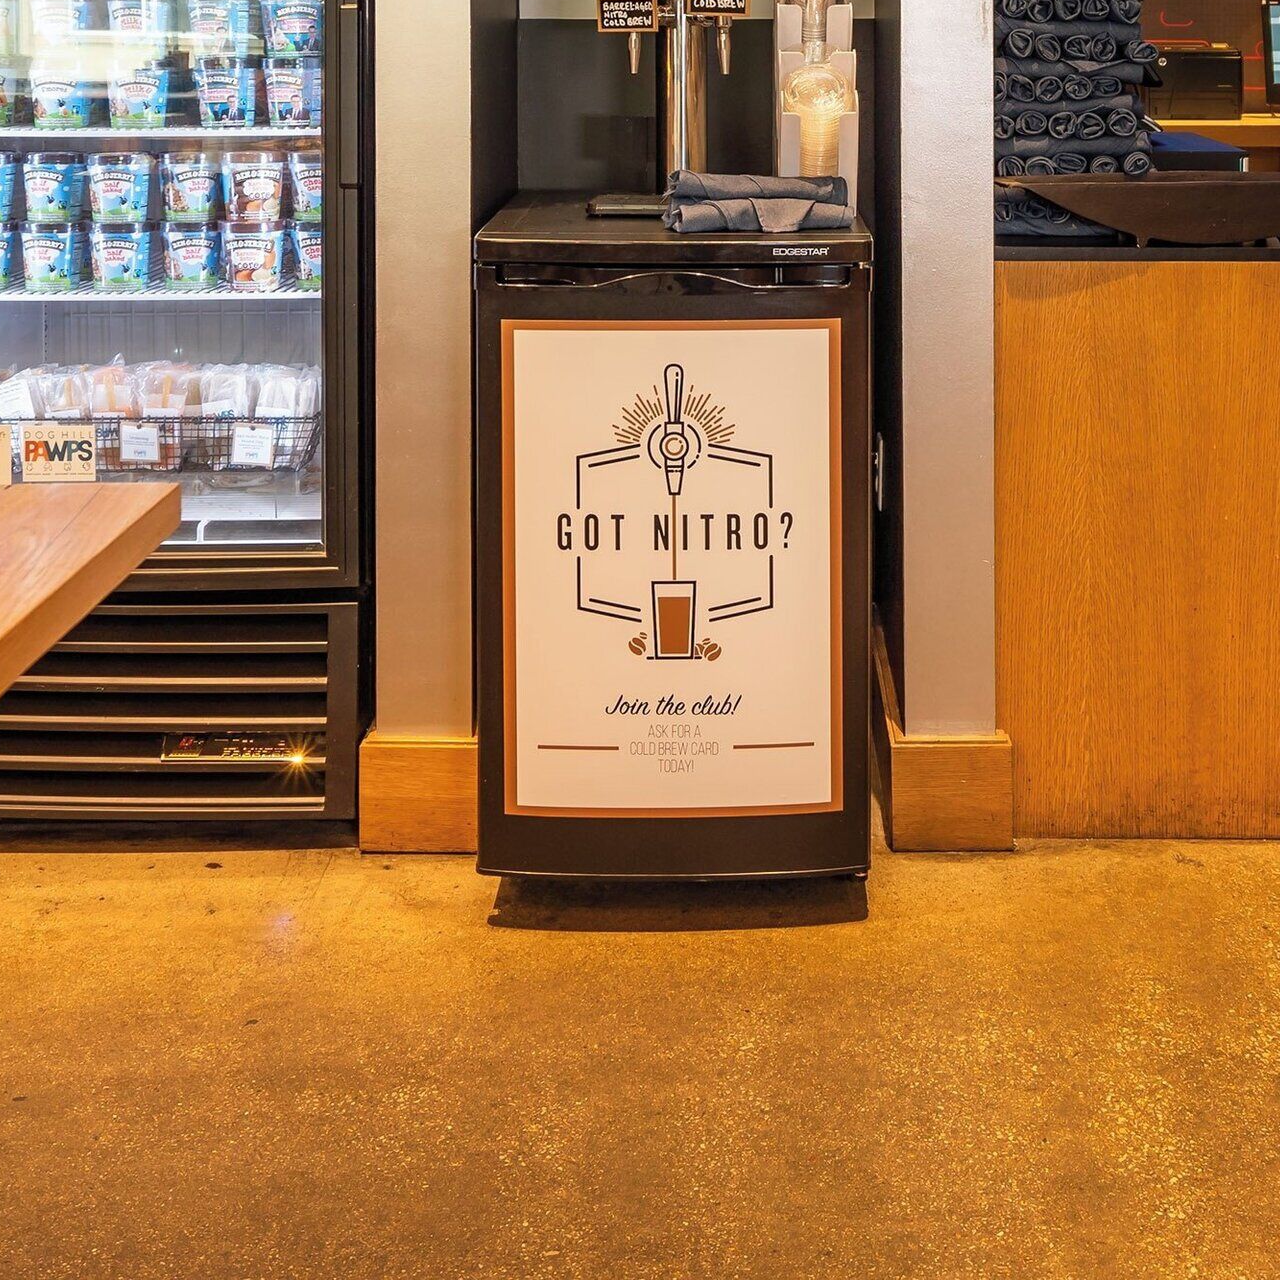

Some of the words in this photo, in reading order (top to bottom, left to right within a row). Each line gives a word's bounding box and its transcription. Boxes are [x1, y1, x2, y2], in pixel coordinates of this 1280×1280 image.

[603, 18, 626, 27] COLD
[627, 16, 652, 27] BREW
[604, 10, 628, 19] NITRO
[772, 247, 829, 256] EDGESTAR
[24, 430, 55, 439] DOG
[61, 430, 94, 439] HILL
[25, 439, 93, 462] PAWPS
[557, 512, 625, 551] GOT
[653, 511, 794, 551] NITRO?
[605, 694, 651, 716] Join
[655, 693, 687, 716] the
[692, 693, 743, 716] club!
[647, 724, 669, 739] ASK
[671, 724, 691, 739] FOR
[693, 724, 702, 738] A
[629, 741, 656, 756] COLD
[658, 741, 688, 756] BREW
[691, 741, 720, 756] CARD
[657, 759, 695, 773] TODAY!
